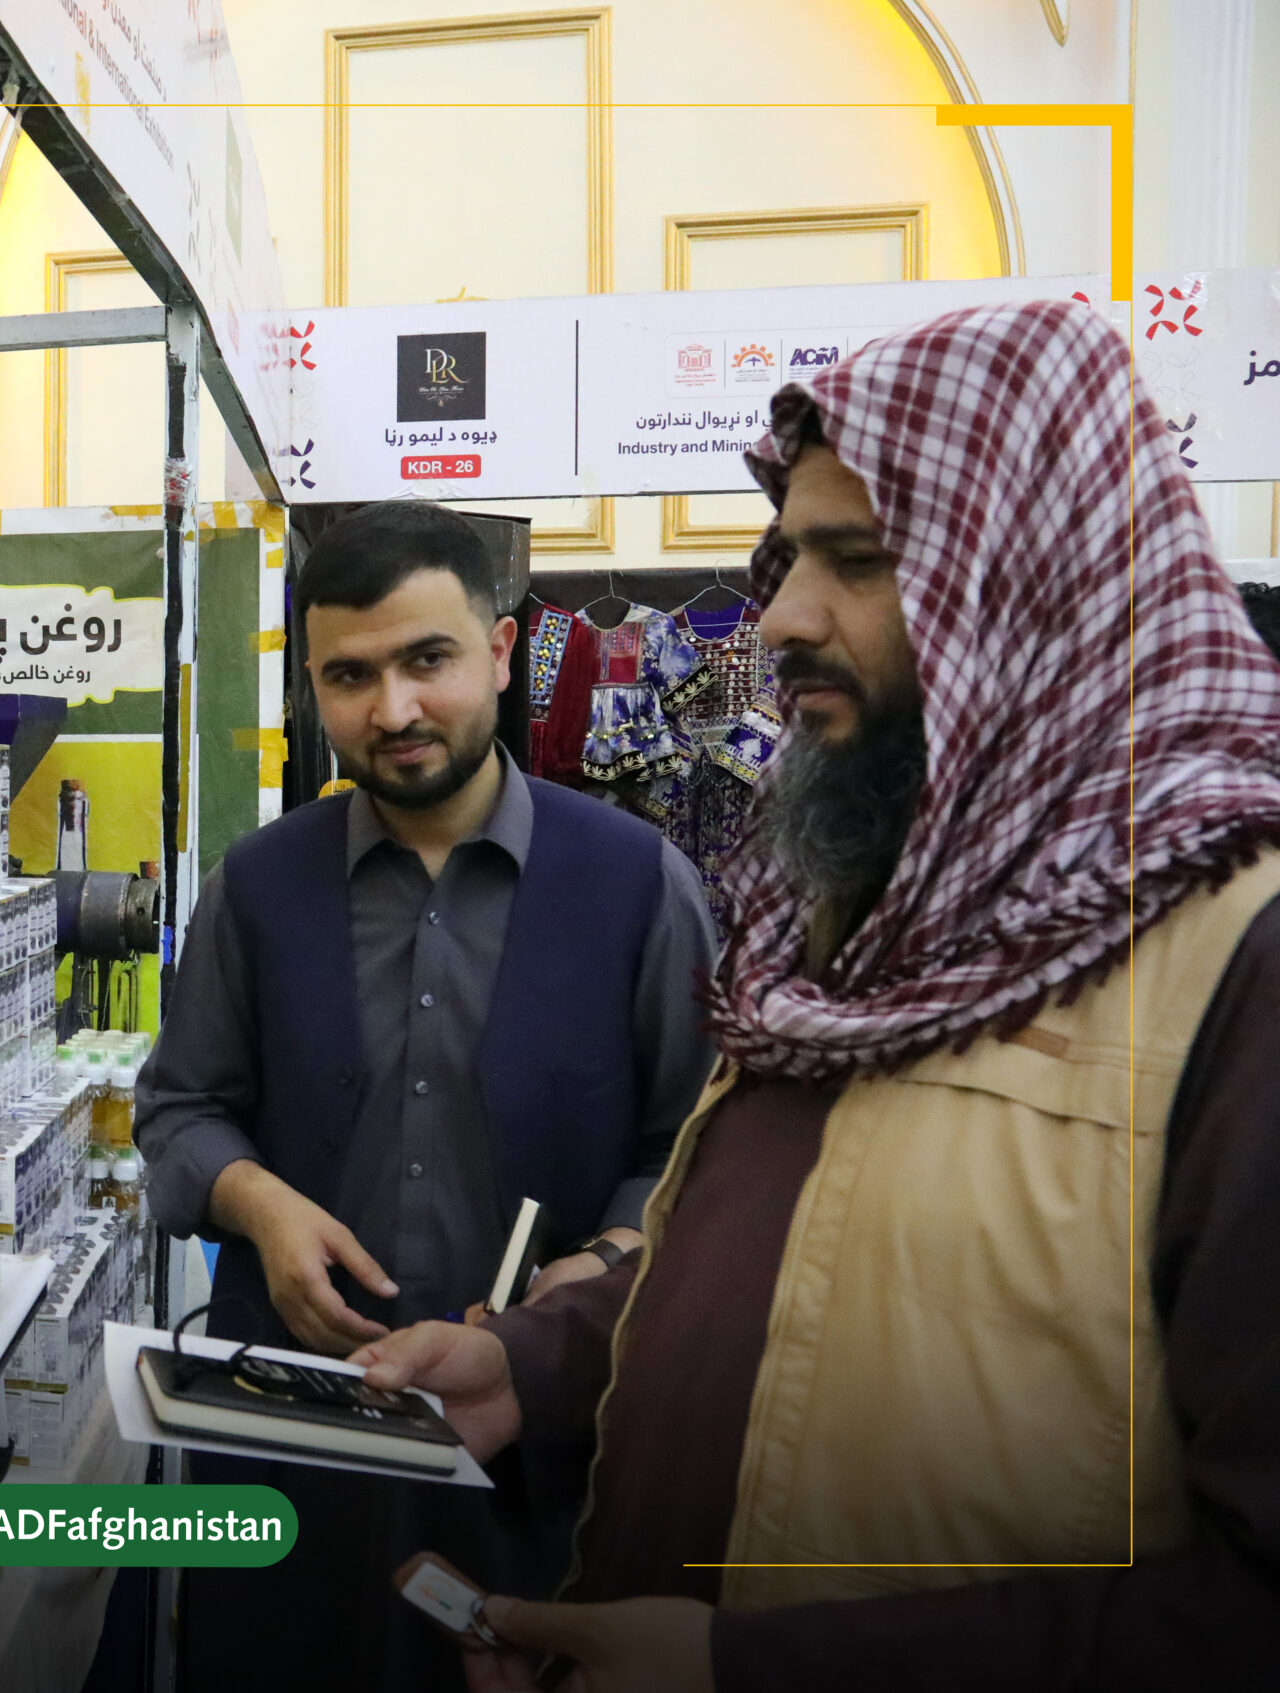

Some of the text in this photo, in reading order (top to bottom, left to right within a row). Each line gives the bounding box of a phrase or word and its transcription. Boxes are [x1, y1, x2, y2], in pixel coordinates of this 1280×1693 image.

[97, 29, 143, 124] International
[145, 105, 174, 171] Exhibition
[636, 412, 692, 429] نندارتون
[745, 410, 758, 427] او
[448, 431, 456, 441] د
[618, 441, 679, 456] Industry
[681, 441, 708, 453] and
[408, 461, 442, 475] KDR
[455, 460, 474, 473] 26
[19, 603, 122, 653] روغن
[53, 667, 90, 684] روغن
